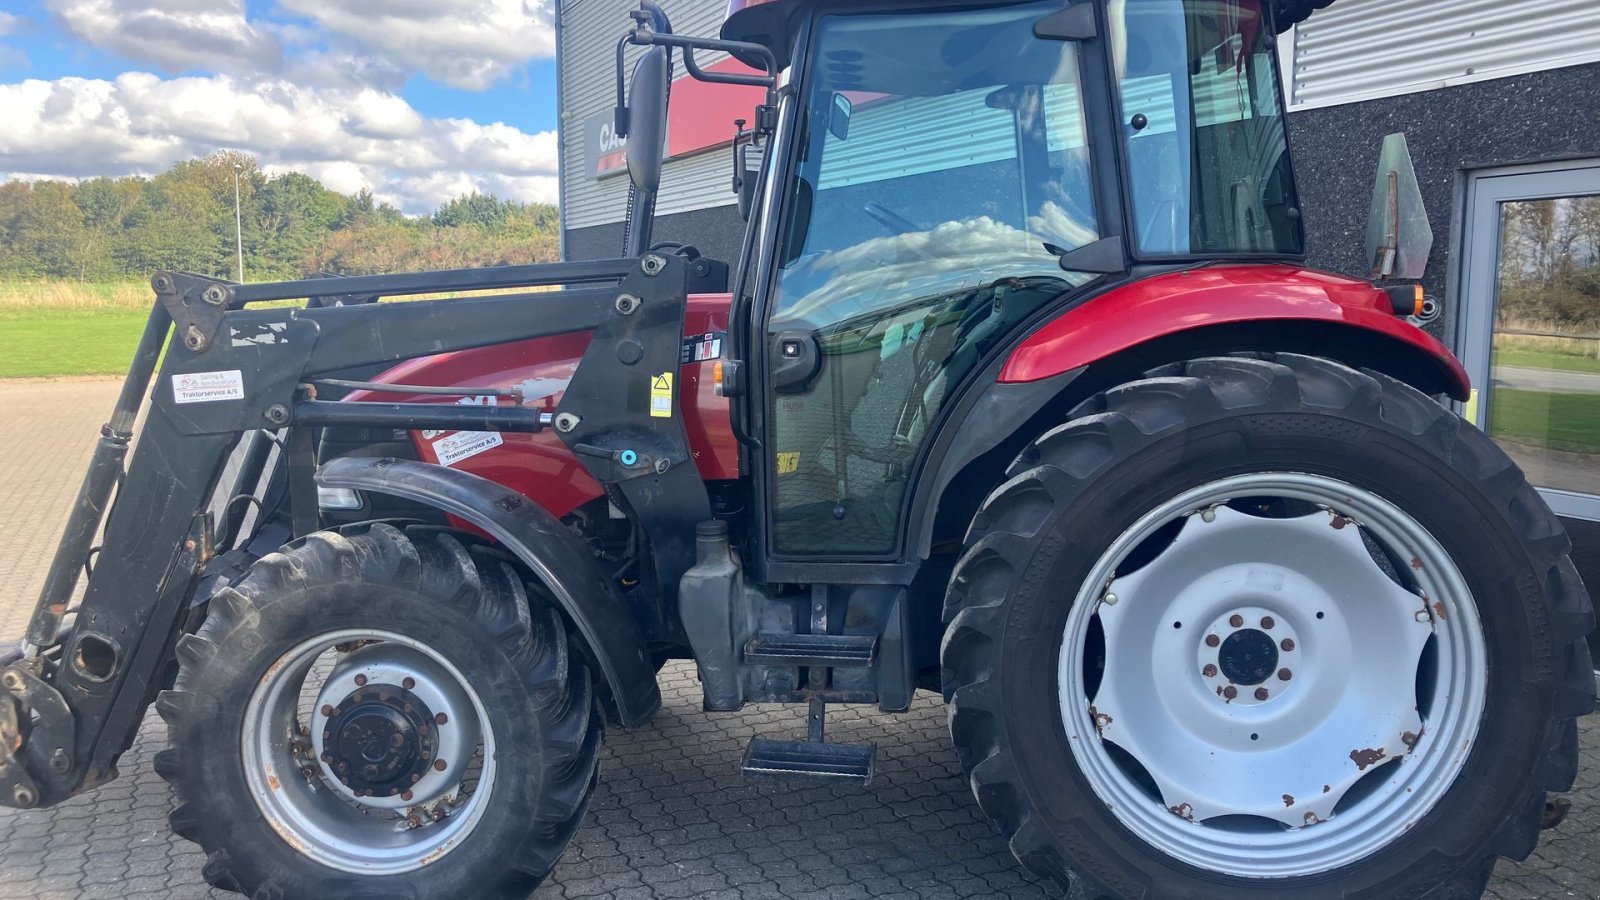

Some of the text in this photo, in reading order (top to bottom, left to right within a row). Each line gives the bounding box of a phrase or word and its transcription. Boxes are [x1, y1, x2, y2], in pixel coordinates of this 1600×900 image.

[182, 390, 225, 398] Traktorservice
[445, 441, 485, 460] Traktorservice
[486, 437, 497, 445] A/S
